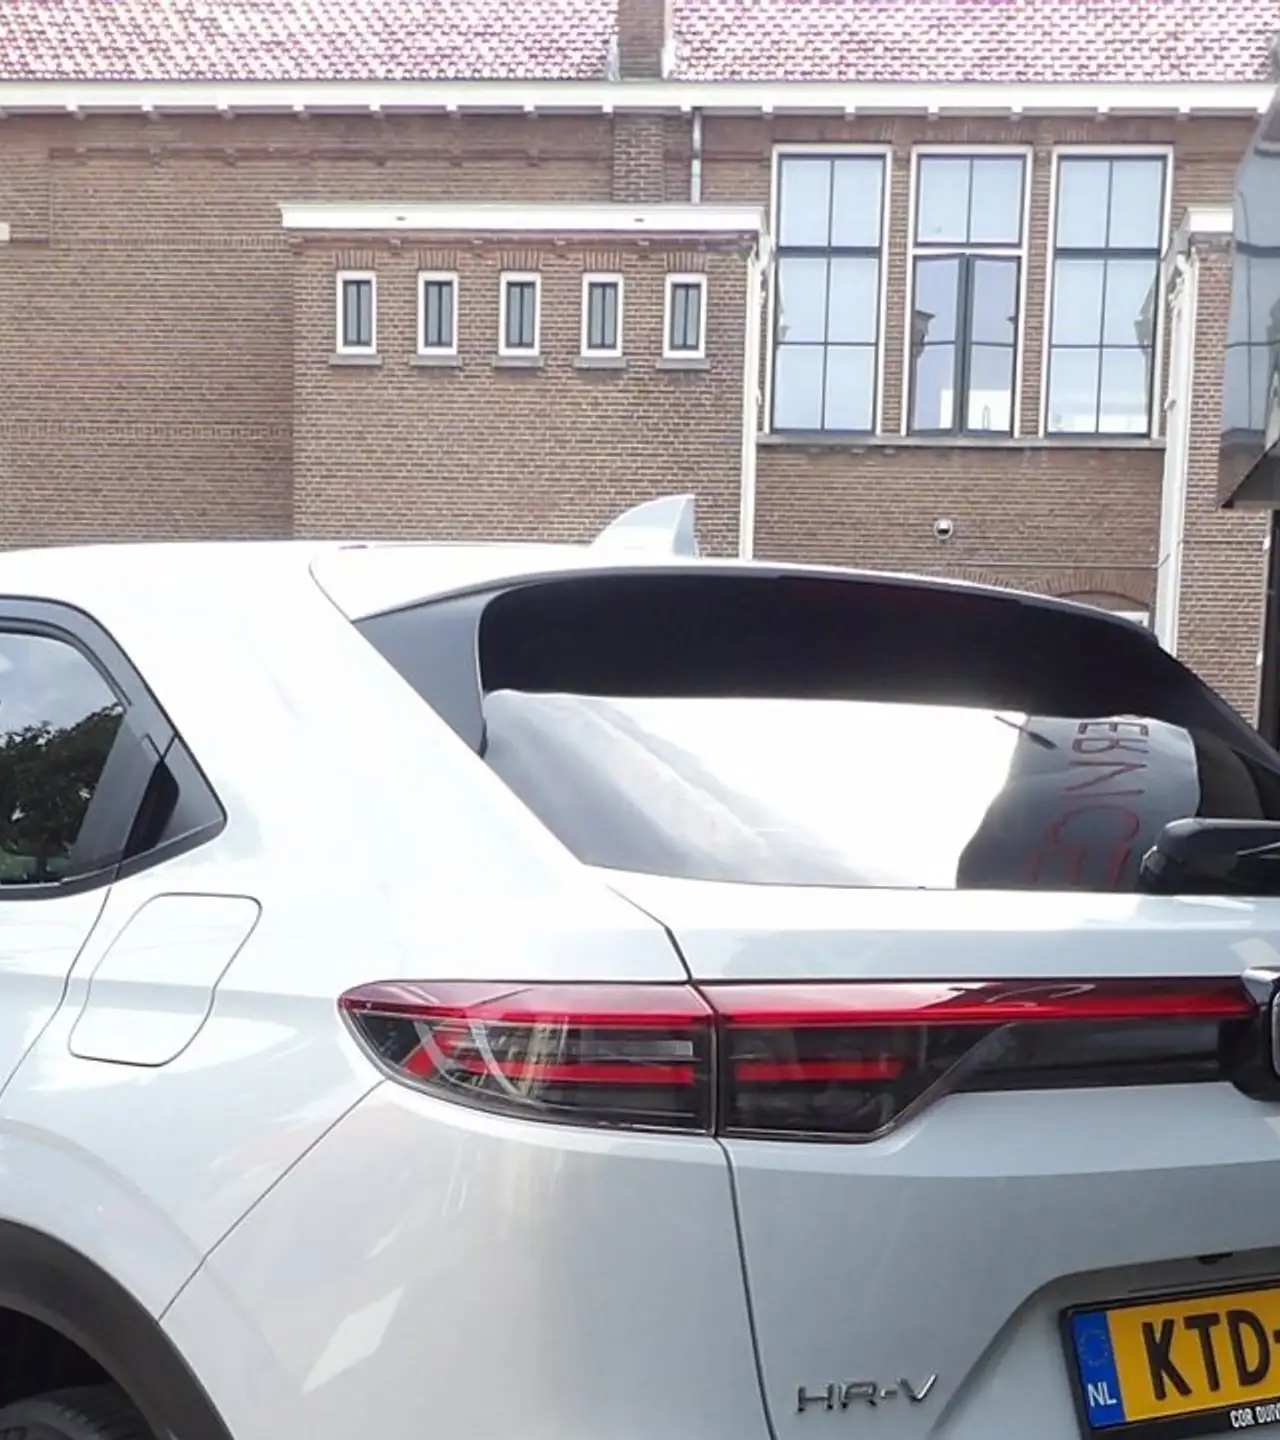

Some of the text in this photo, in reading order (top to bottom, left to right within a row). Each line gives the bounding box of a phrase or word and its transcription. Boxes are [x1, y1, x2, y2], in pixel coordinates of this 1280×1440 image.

[797, 1373, 939, 1414] HR-V
[1087, 1381, 1118, 1408] NL
[1229, 1407, 1255, 1429] COR
